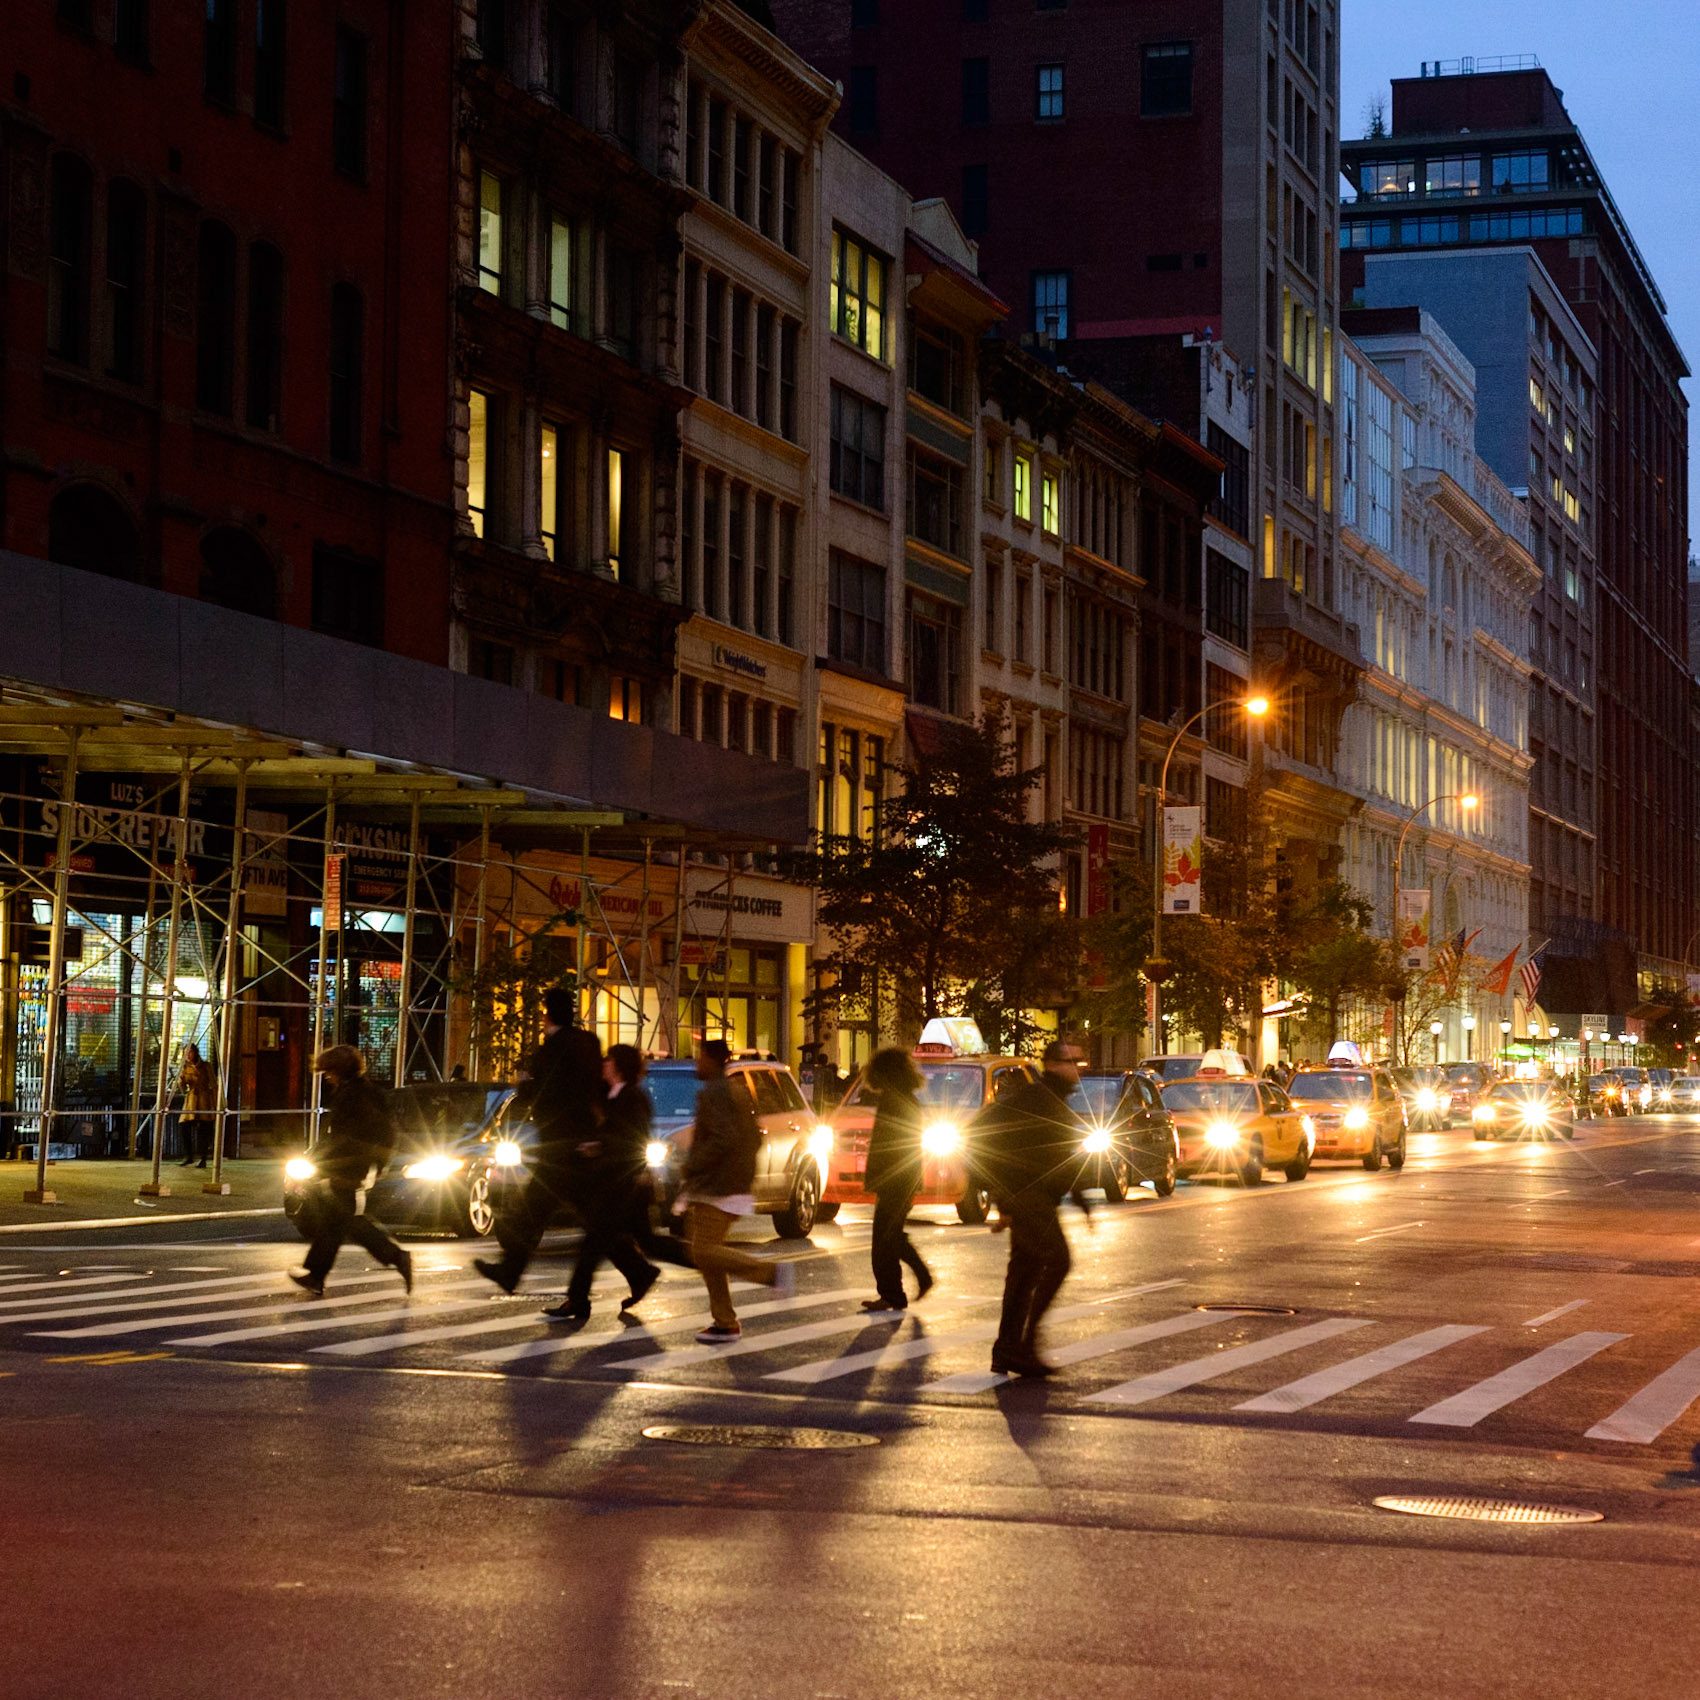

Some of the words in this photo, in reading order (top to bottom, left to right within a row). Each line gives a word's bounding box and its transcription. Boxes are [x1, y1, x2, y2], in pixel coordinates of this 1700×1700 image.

[110, 782, 145, 804] LUZ'S
[119, 812, 206, 855] REPAR
[334, 824, 430, 862] OCKSMIH
[267, 867, 288, 888] AVE
[695, 890, 749, 913] STARBCKS
[750, 897, 782, 917] COFFEE
